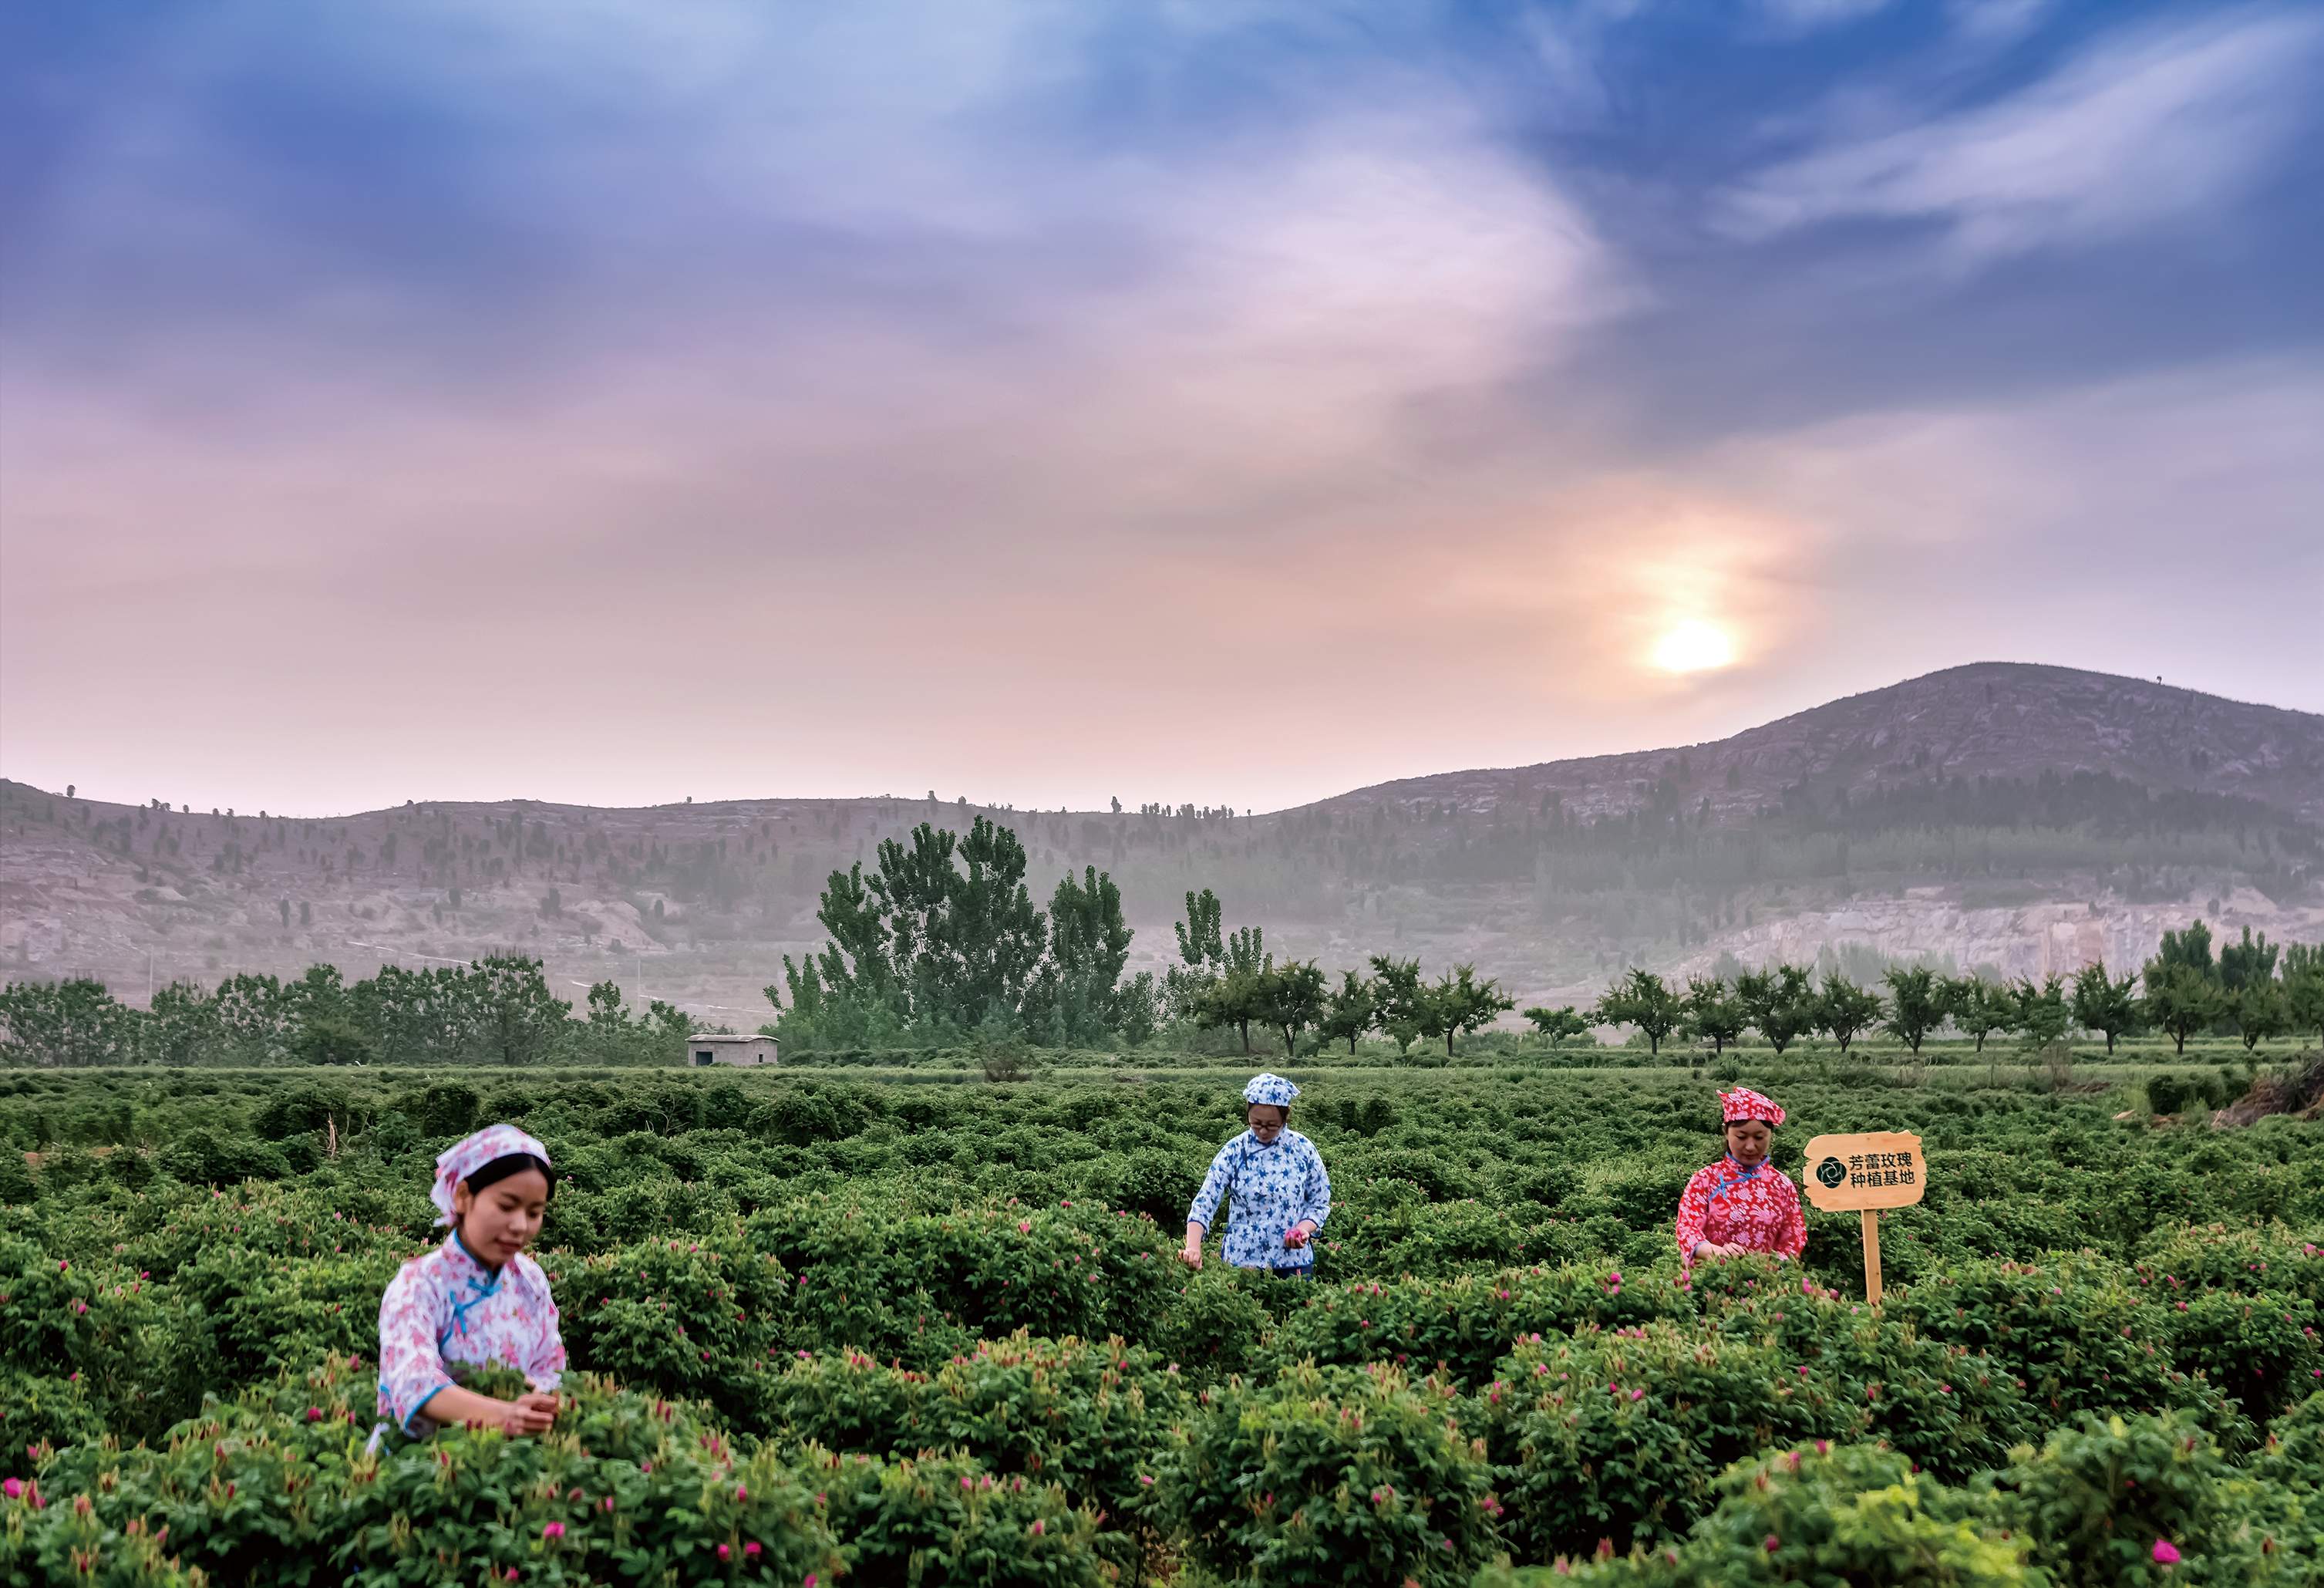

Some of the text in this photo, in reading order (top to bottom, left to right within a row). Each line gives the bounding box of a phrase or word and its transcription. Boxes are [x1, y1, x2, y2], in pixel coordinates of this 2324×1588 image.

[1849, 1151, 1912, 1170] 芳蕾玫瑰
[1851, 1168, 1915, 1188] 种植基地
